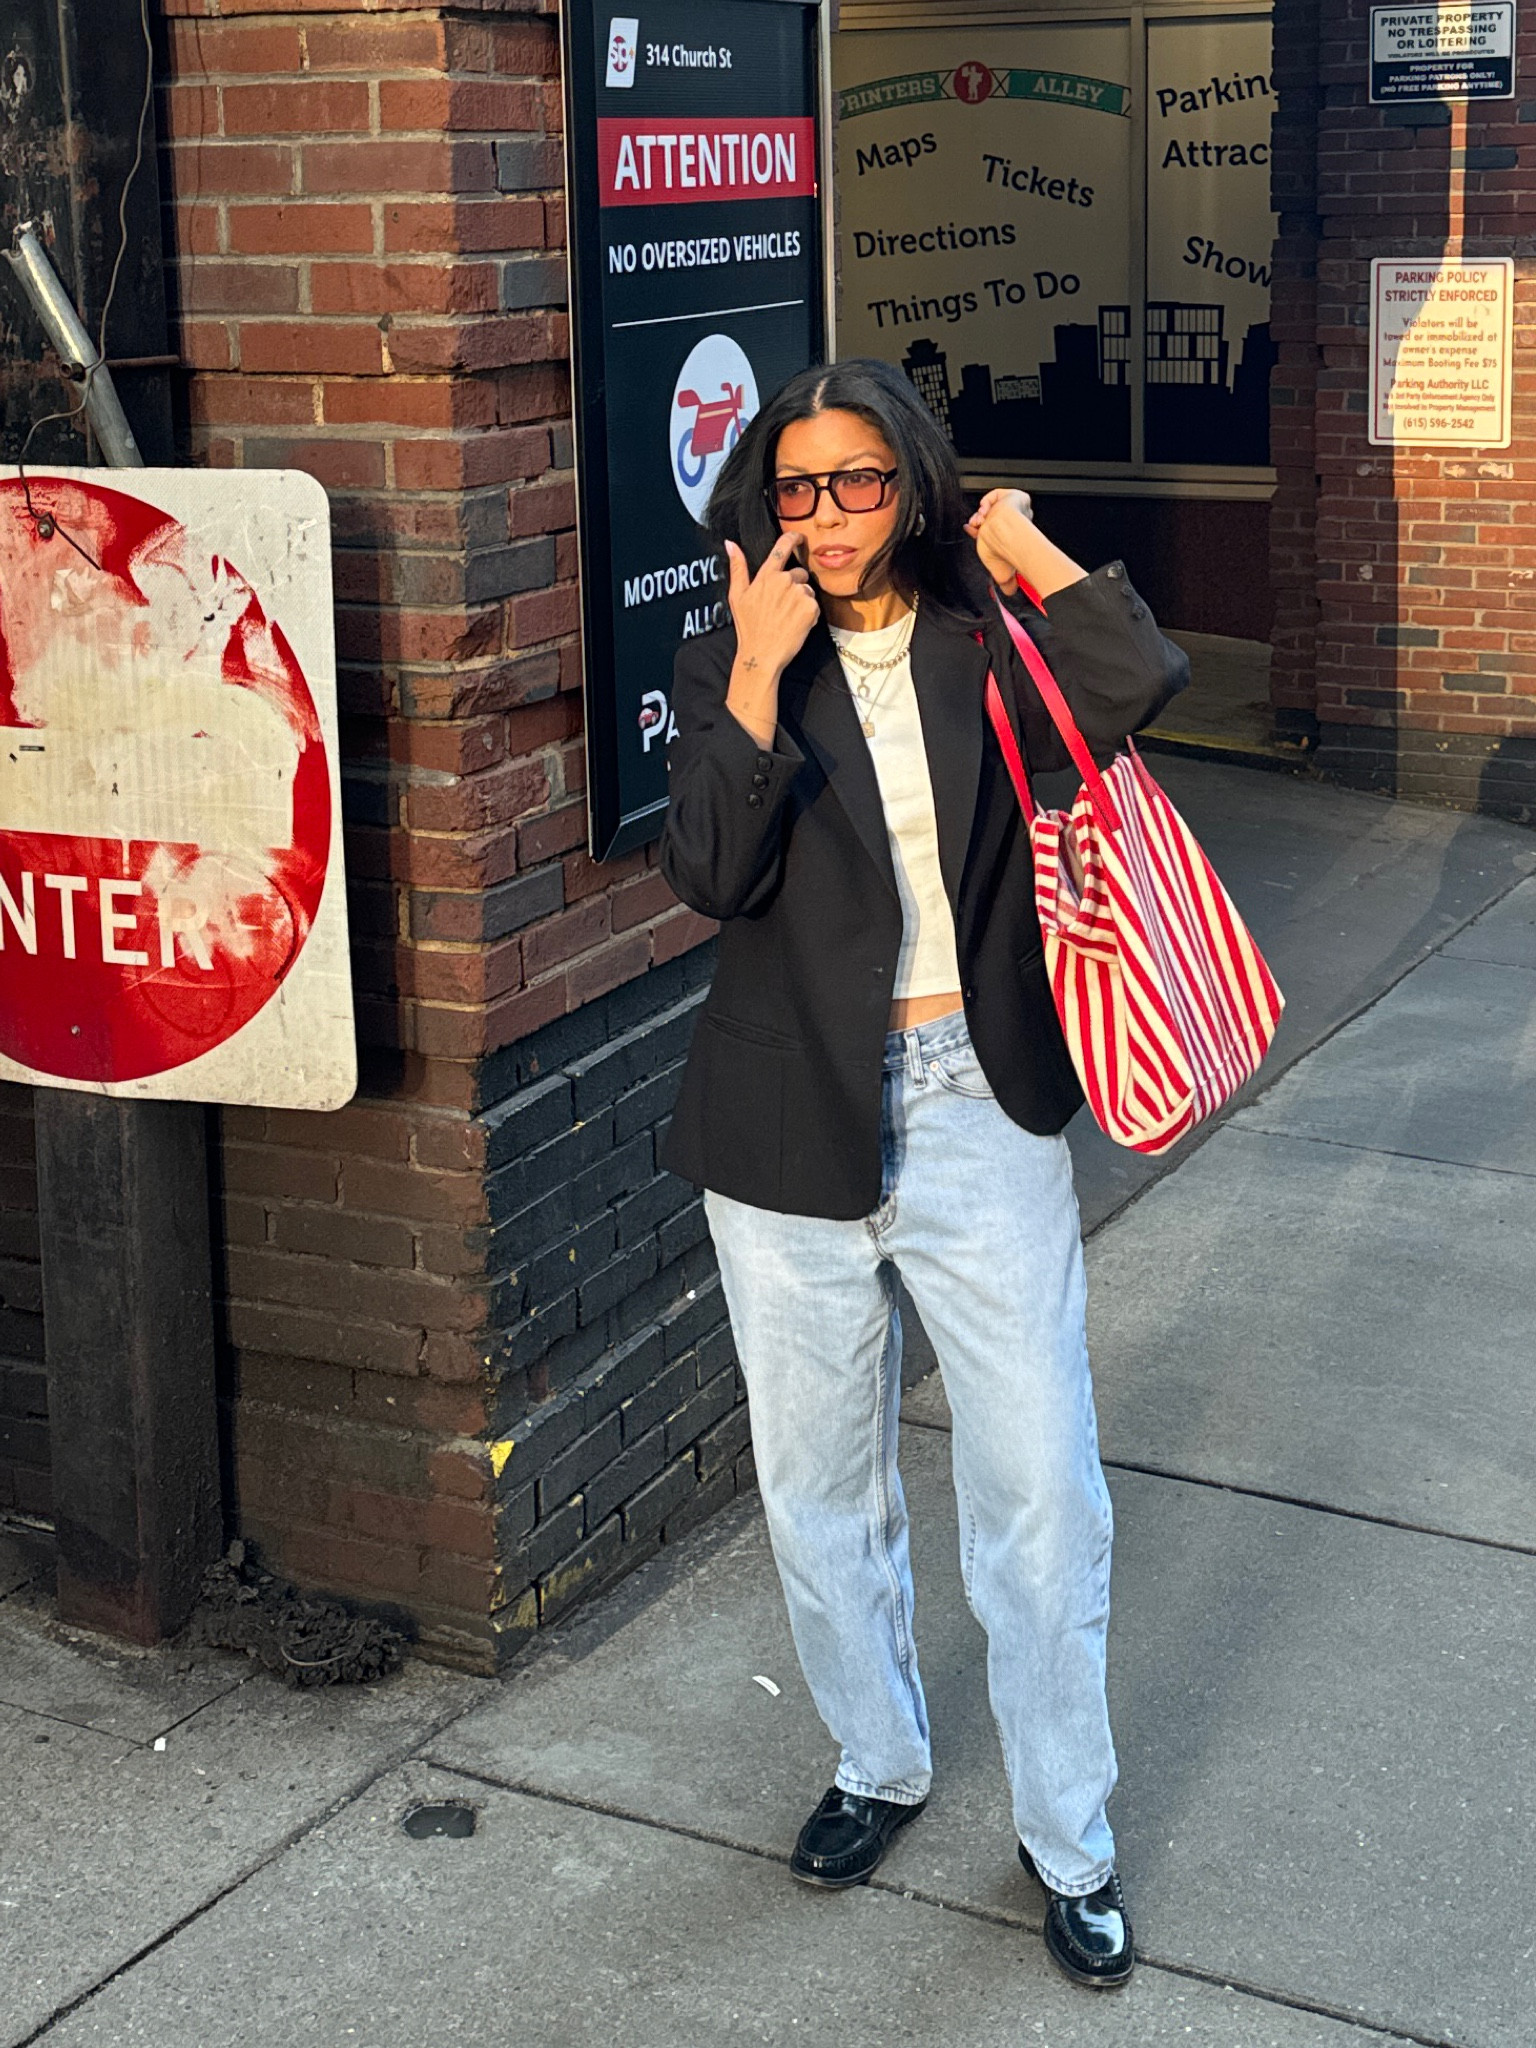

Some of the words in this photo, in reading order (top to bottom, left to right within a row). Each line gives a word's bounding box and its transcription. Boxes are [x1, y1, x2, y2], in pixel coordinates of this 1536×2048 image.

[1381, 15, 1433, 26] PRIVATE
[1437, 11, 1504, 24] PROPERTY
[1388, 28, 1406, 37] NO
[1410, 24, 1496, 36] TRESPASSING
[1397, 40, 1415, 49] OR
[1418, 36, 1487, 49] LOITERING
[646, 44, 670, 66] 314
[672, 45, 717, 68] Church
[719, 47, 732, 69] St
[1410, 64, 1454, 73] PROPERTY
[1456, 62, 1474, 71] FOR
[1389, 75, 1427, 83] PARKING
[1032, 76, 1104, 103] ALLEY
[1398, 83, 1420, 92] FREE
[1421, 82, 1459, 91] PARKING
[1156, 72, 1272, 118] Parkin
[856, 132, 937, 176] Maps
[614, 133, 796, 190] ATTENTION
[982, 153, 1094, 208] Tickets
[853, 222, 1016, 258] Directions
[608, 243, 637, 274] NO
[641, 237, 731, 270] OVERSIZED
[733, 230, 800, 262] VEHICLES
[1395, 271, 1444, 283] PARKING
[1447, 271, 1487, 283] POLICY
[867, 290, 978, 333] Things
[983, 278, 1026, 308] To
[1033, 271, 1080, 300] Do
[1385, 290, 1436, 302] STRICTLY
[1439, 290, 1498, 302] ENFORCED
[1402, 317, 1445, 328] Violators
[1448, 317, 1463, 328] will
[1466, 317, 1478, 328] be
[1384, 331, 1411, 342] towed
[1414, 333, 1424, 342] or
[1427, 331, 1484, 342] immobilized
[1487, 332, 1497, 342] at
[1439, 347, 1477, 357] expense
[1428, 358, 1461, 370] Booting
[1464, 359, 1479, 368] Fee
[1482, 358, 1497, 369] $75
[1391, 378, 1424, 390] Parking
[1427, 378, 1469, 390] Authority
[1471, 379, 1489, 390] LLC
[1403, 416, 1427, 430] (615)
[1430, 417, 1474, 429] 596-2542
[624, 554, 725, 608] MOTORCYC
[0, 871, 214, 970] NTER
